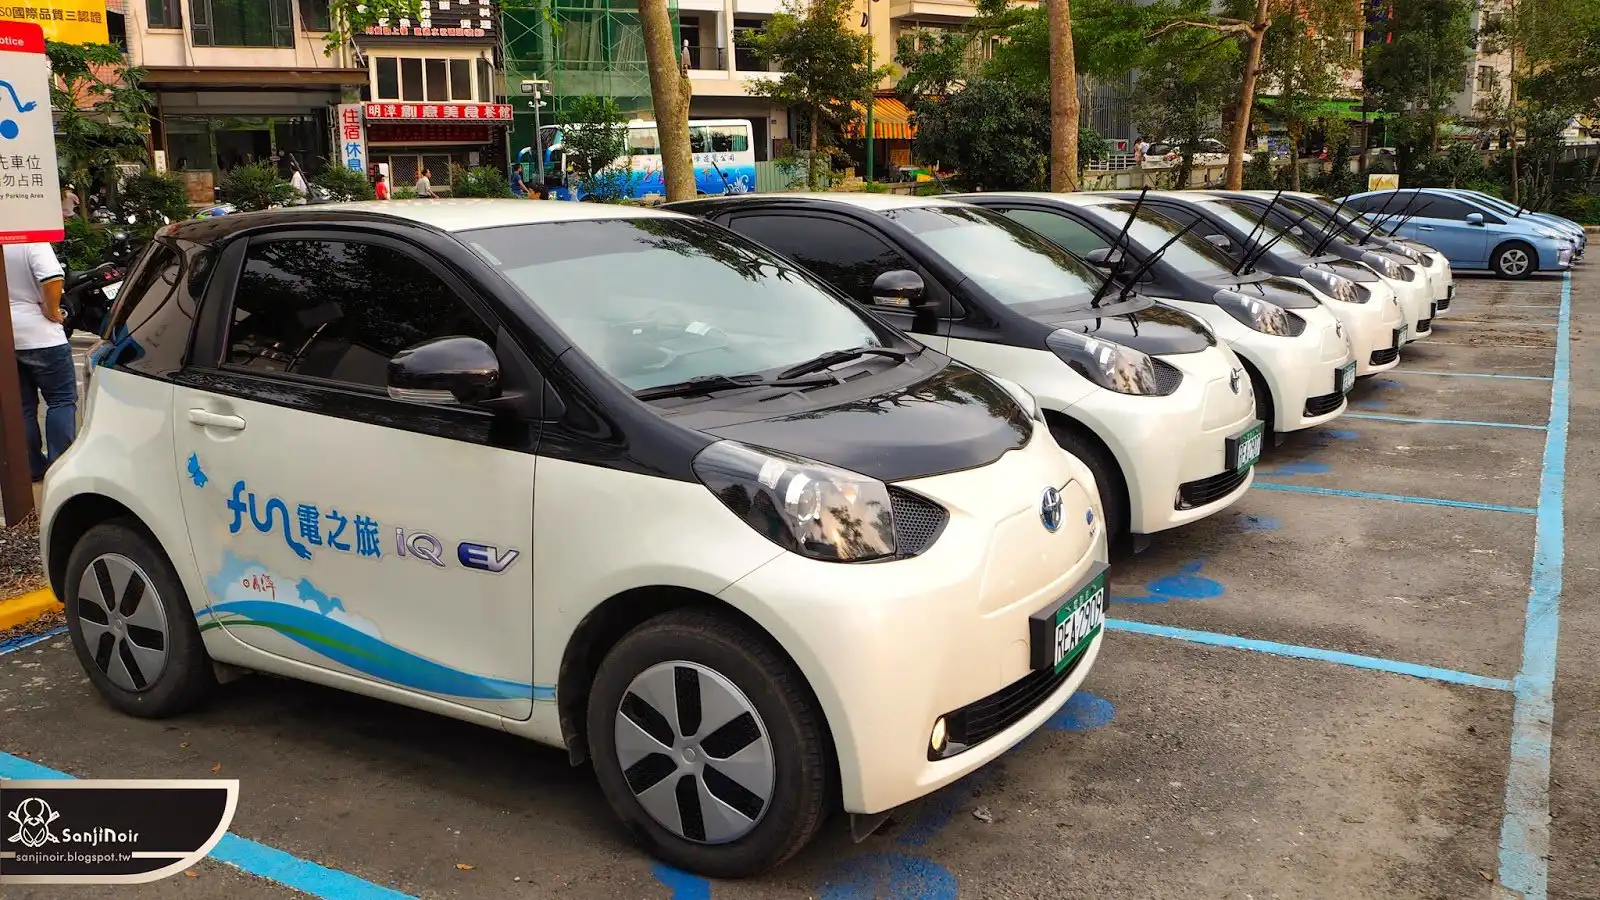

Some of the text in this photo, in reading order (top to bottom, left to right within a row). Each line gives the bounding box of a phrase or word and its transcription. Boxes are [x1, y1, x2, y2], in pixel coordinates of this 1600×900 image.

[0, 174, 43, 187] 勿占用
[457, 541, 520, 573] EV
